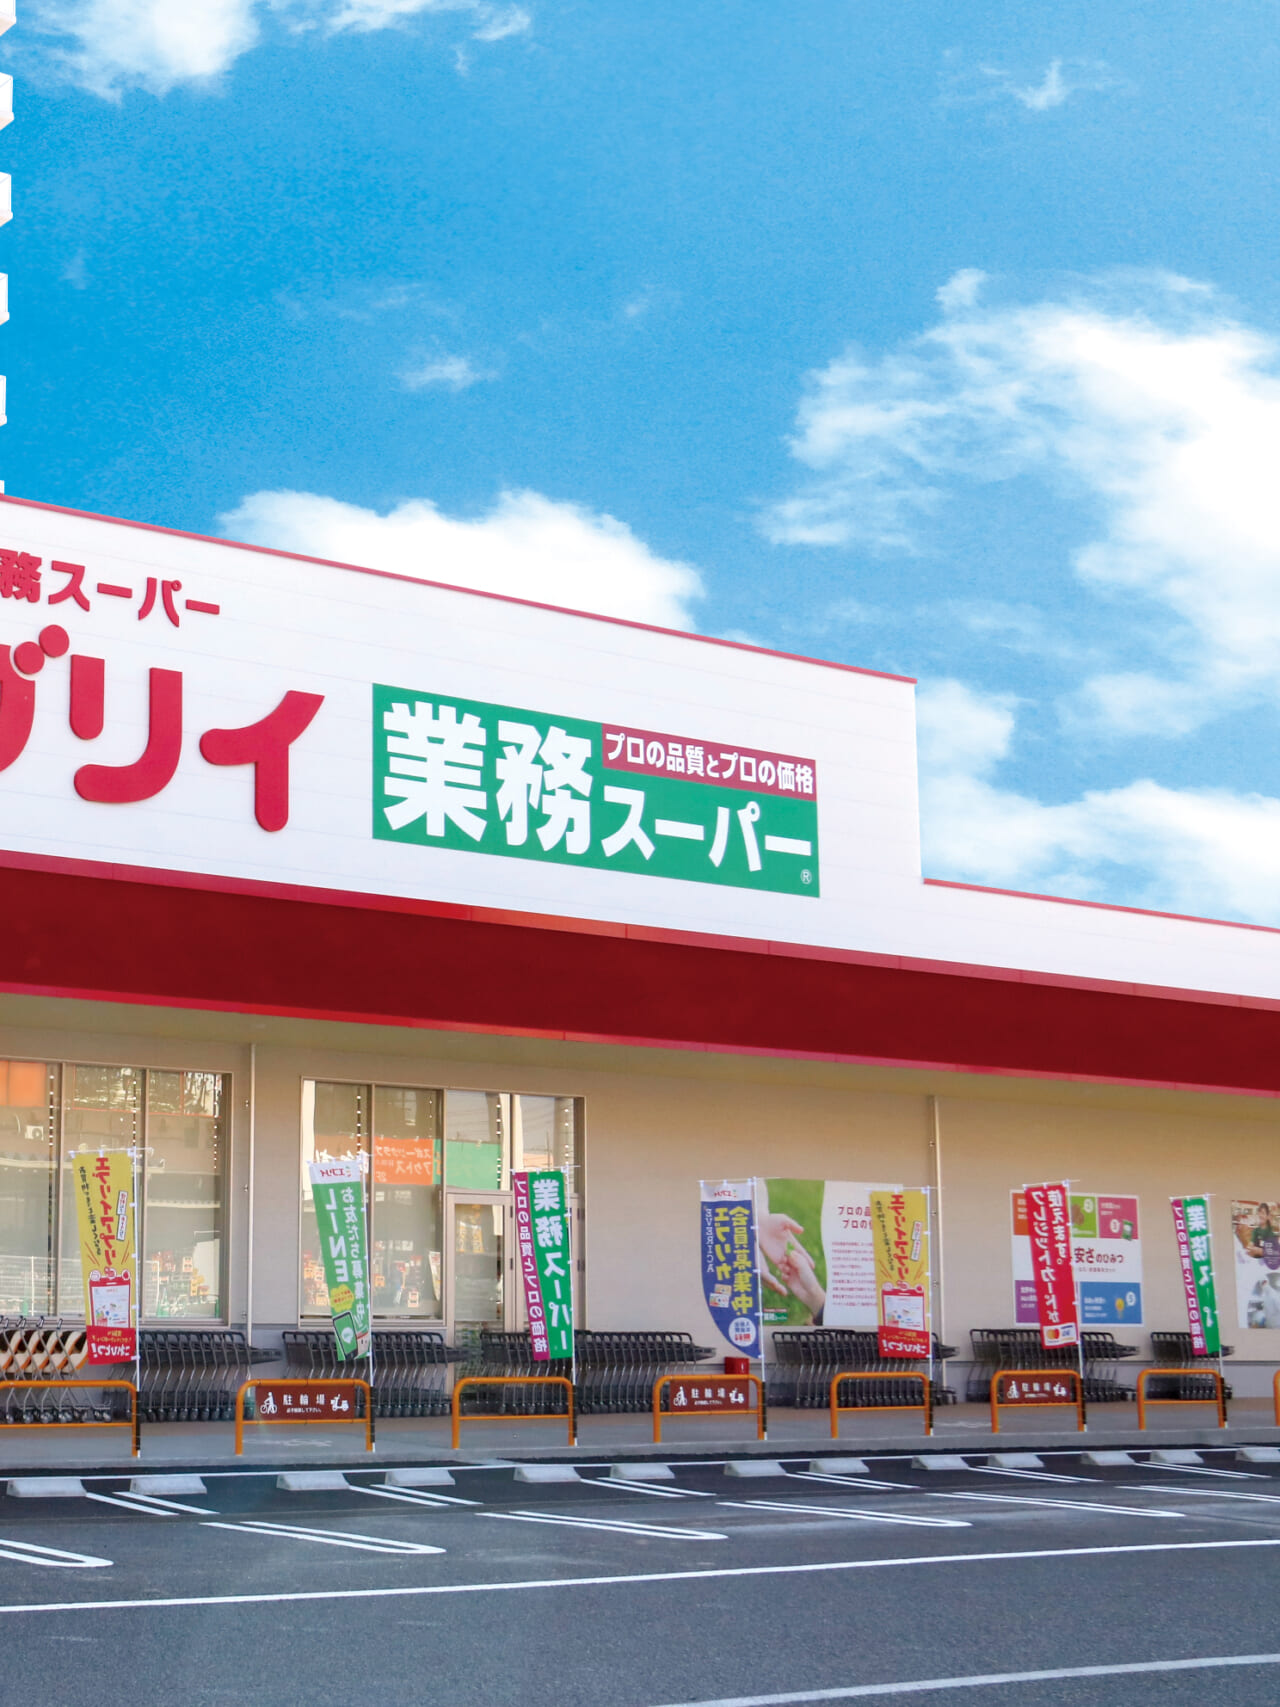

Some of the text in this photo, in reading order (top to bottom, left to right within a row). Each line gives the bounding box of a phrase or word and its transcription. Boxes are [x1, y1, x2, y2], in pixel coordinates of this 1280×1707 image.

[383, 700, 812, 873] 業務スーパー
[605, 732, 814, 796] プロの品質とプロの価格
[283, 1394, 326, 1406] 駐輪場
